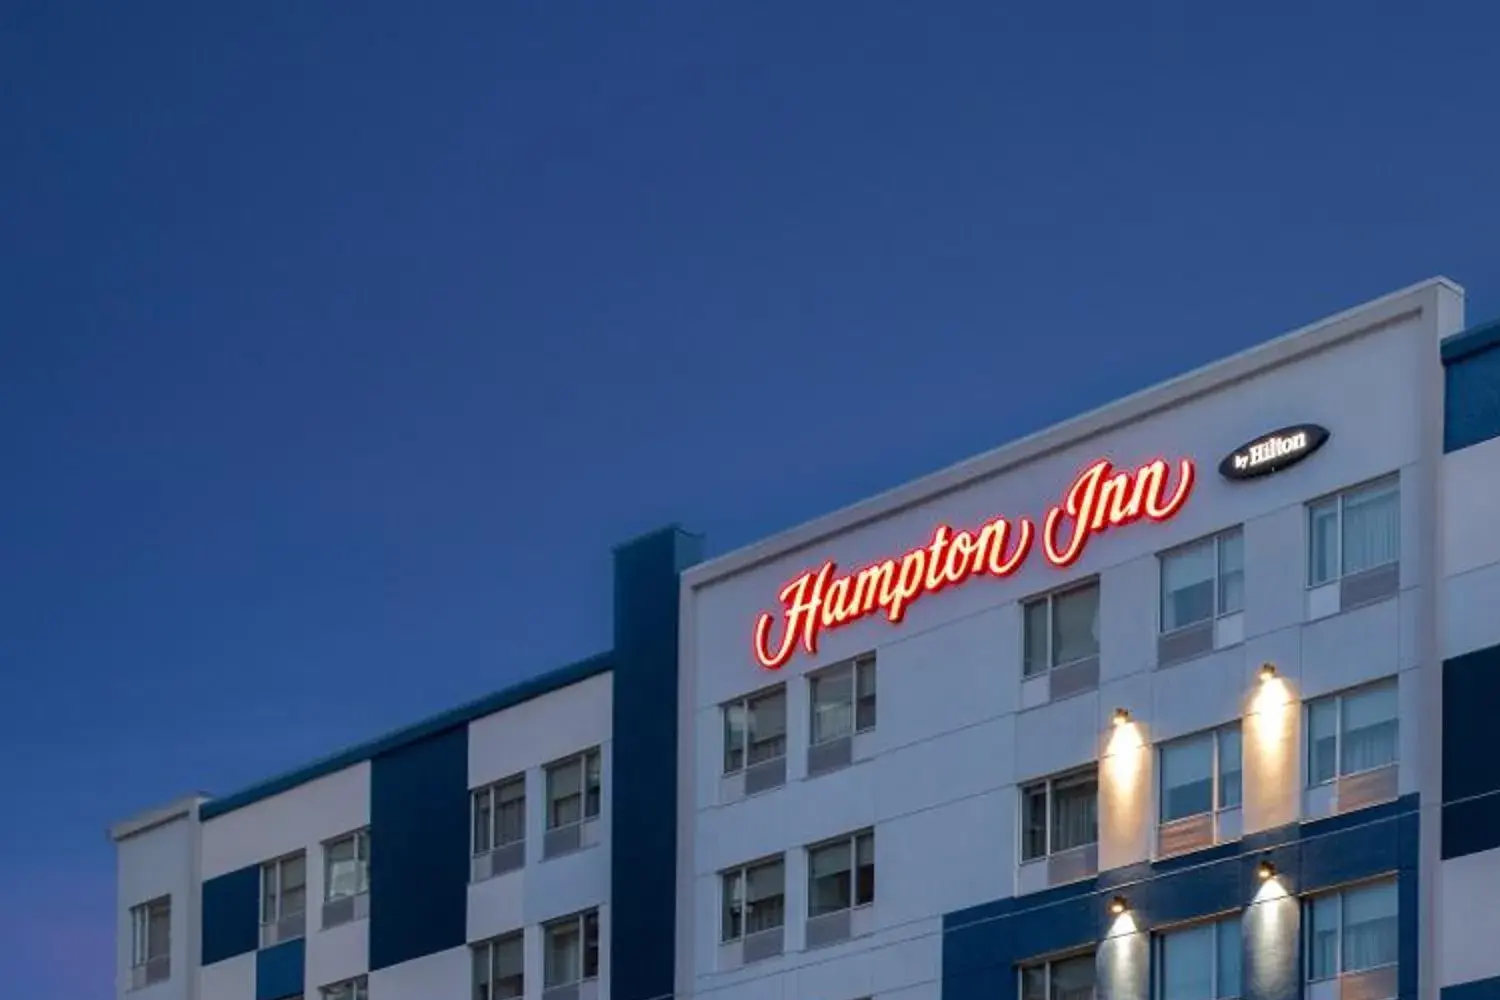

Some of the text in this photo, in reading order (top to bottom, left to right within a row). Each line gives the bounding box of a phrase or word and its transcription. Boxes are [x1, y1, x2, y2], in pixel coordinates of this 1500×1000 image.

[1234, 431, 1306, 470] by Hilton
[754, 457, 1194, 669] Hampton Inn
